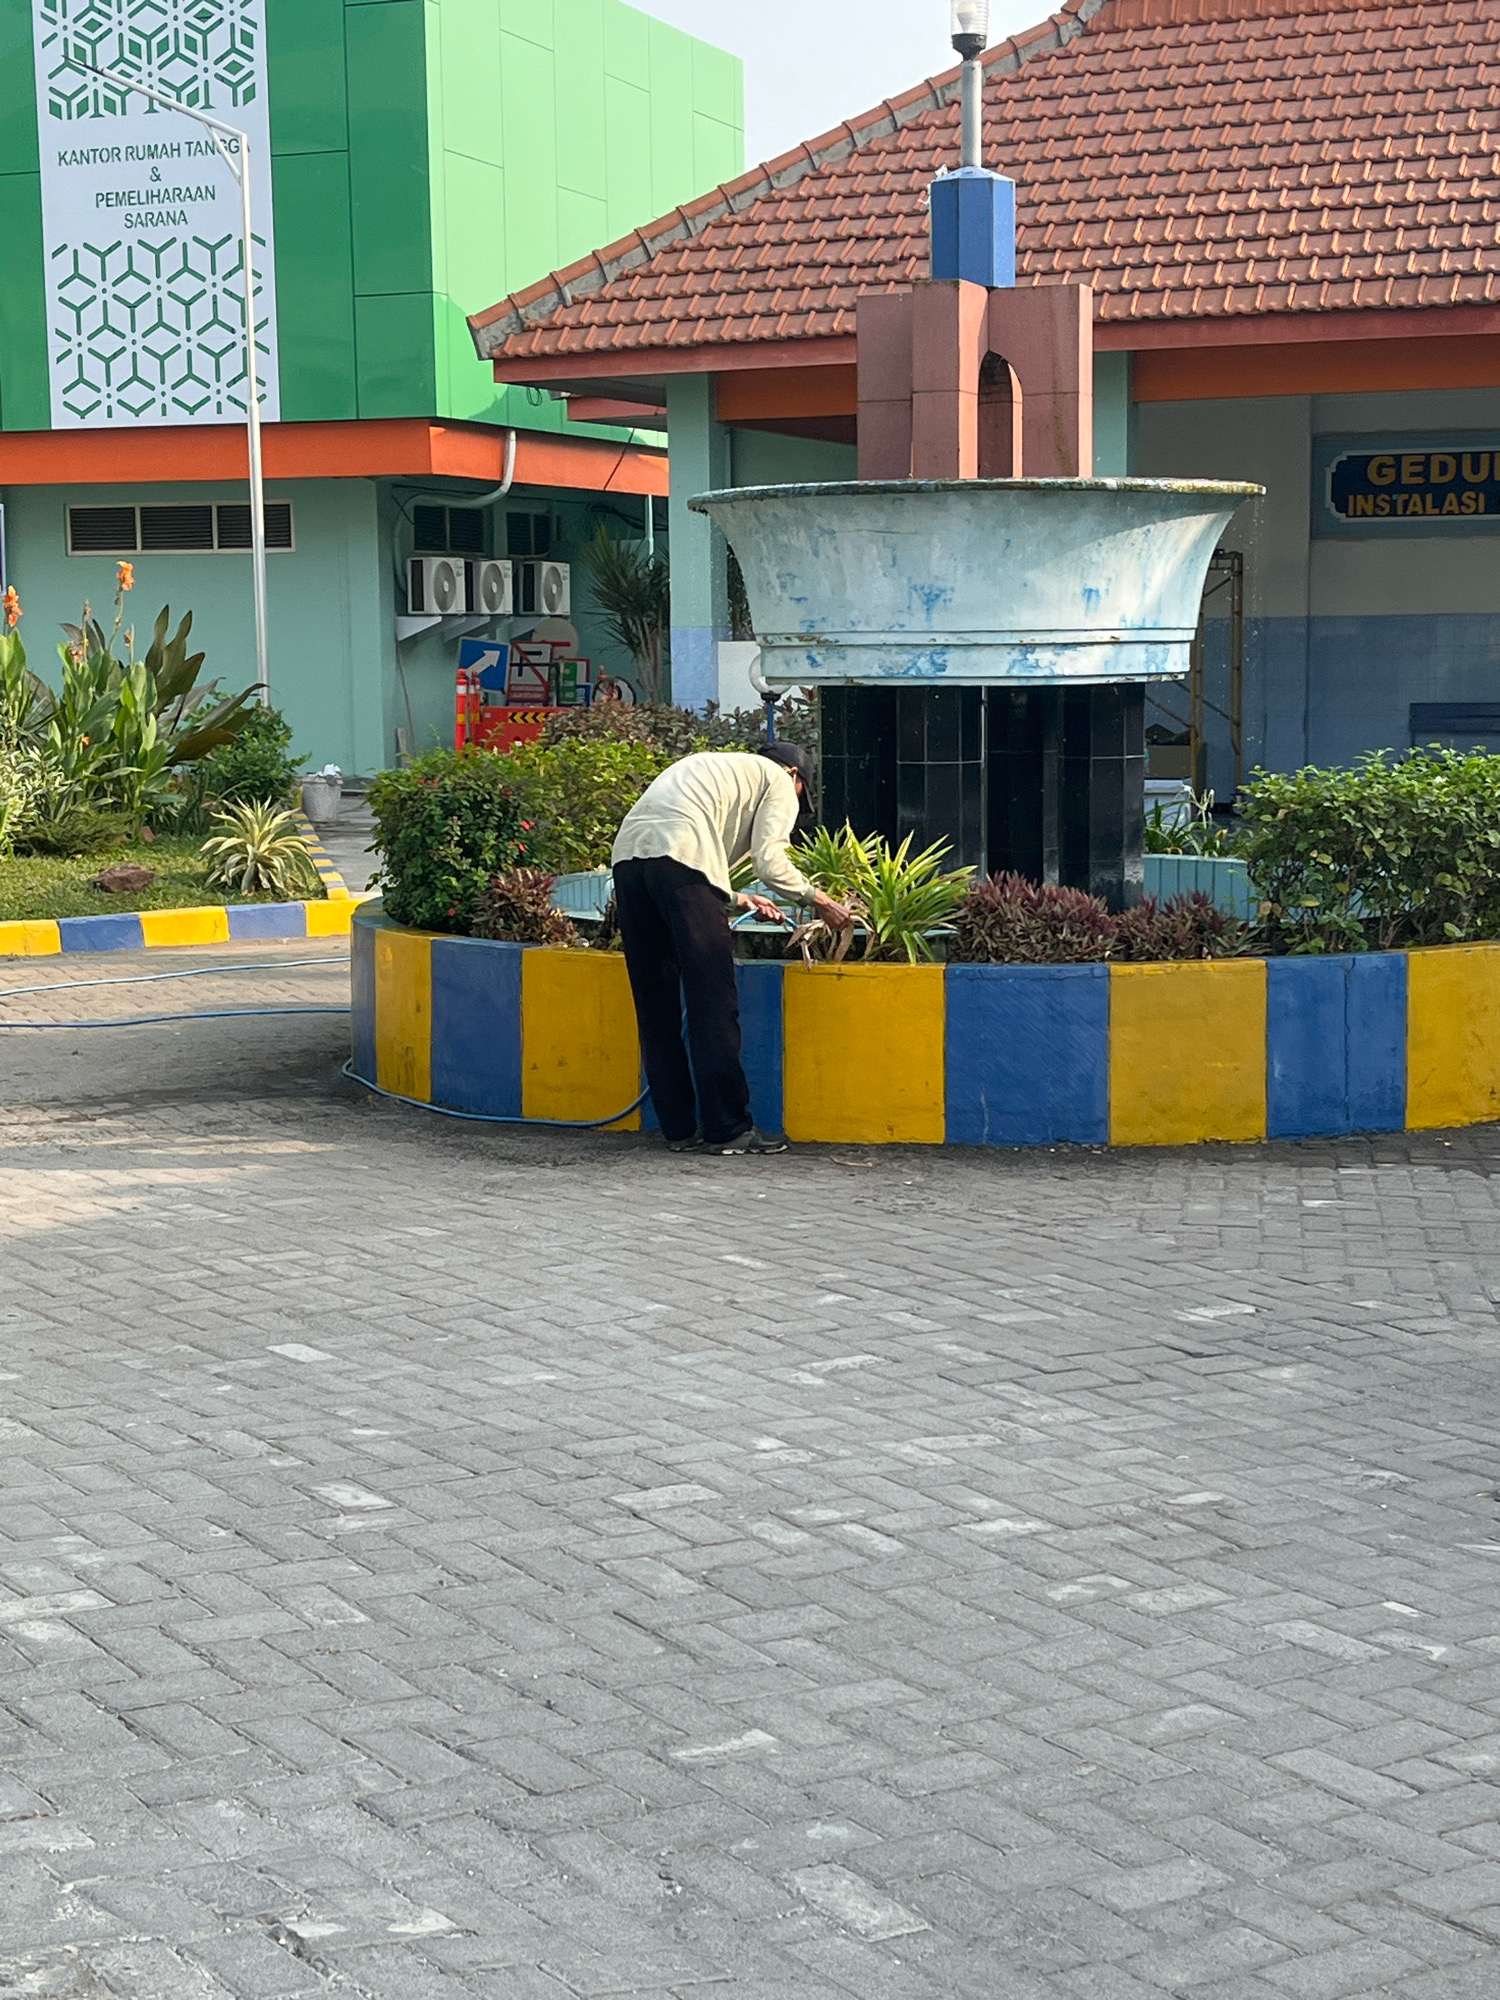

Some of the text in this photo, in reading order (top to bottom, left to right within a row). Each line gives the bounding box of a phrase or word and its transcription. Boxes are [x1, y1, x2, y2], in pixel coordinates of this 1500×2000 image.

[58, 147, 121, 167] KANTOR
[125, 142, 181, 162] RUMAH
[149, 165, 162, 182] &
[95, 184, 216, 209] PEMELIHARAAN
[124, 209, 188, 229] SARANA
[1347, 490, 1486, 516] INSTALASI
